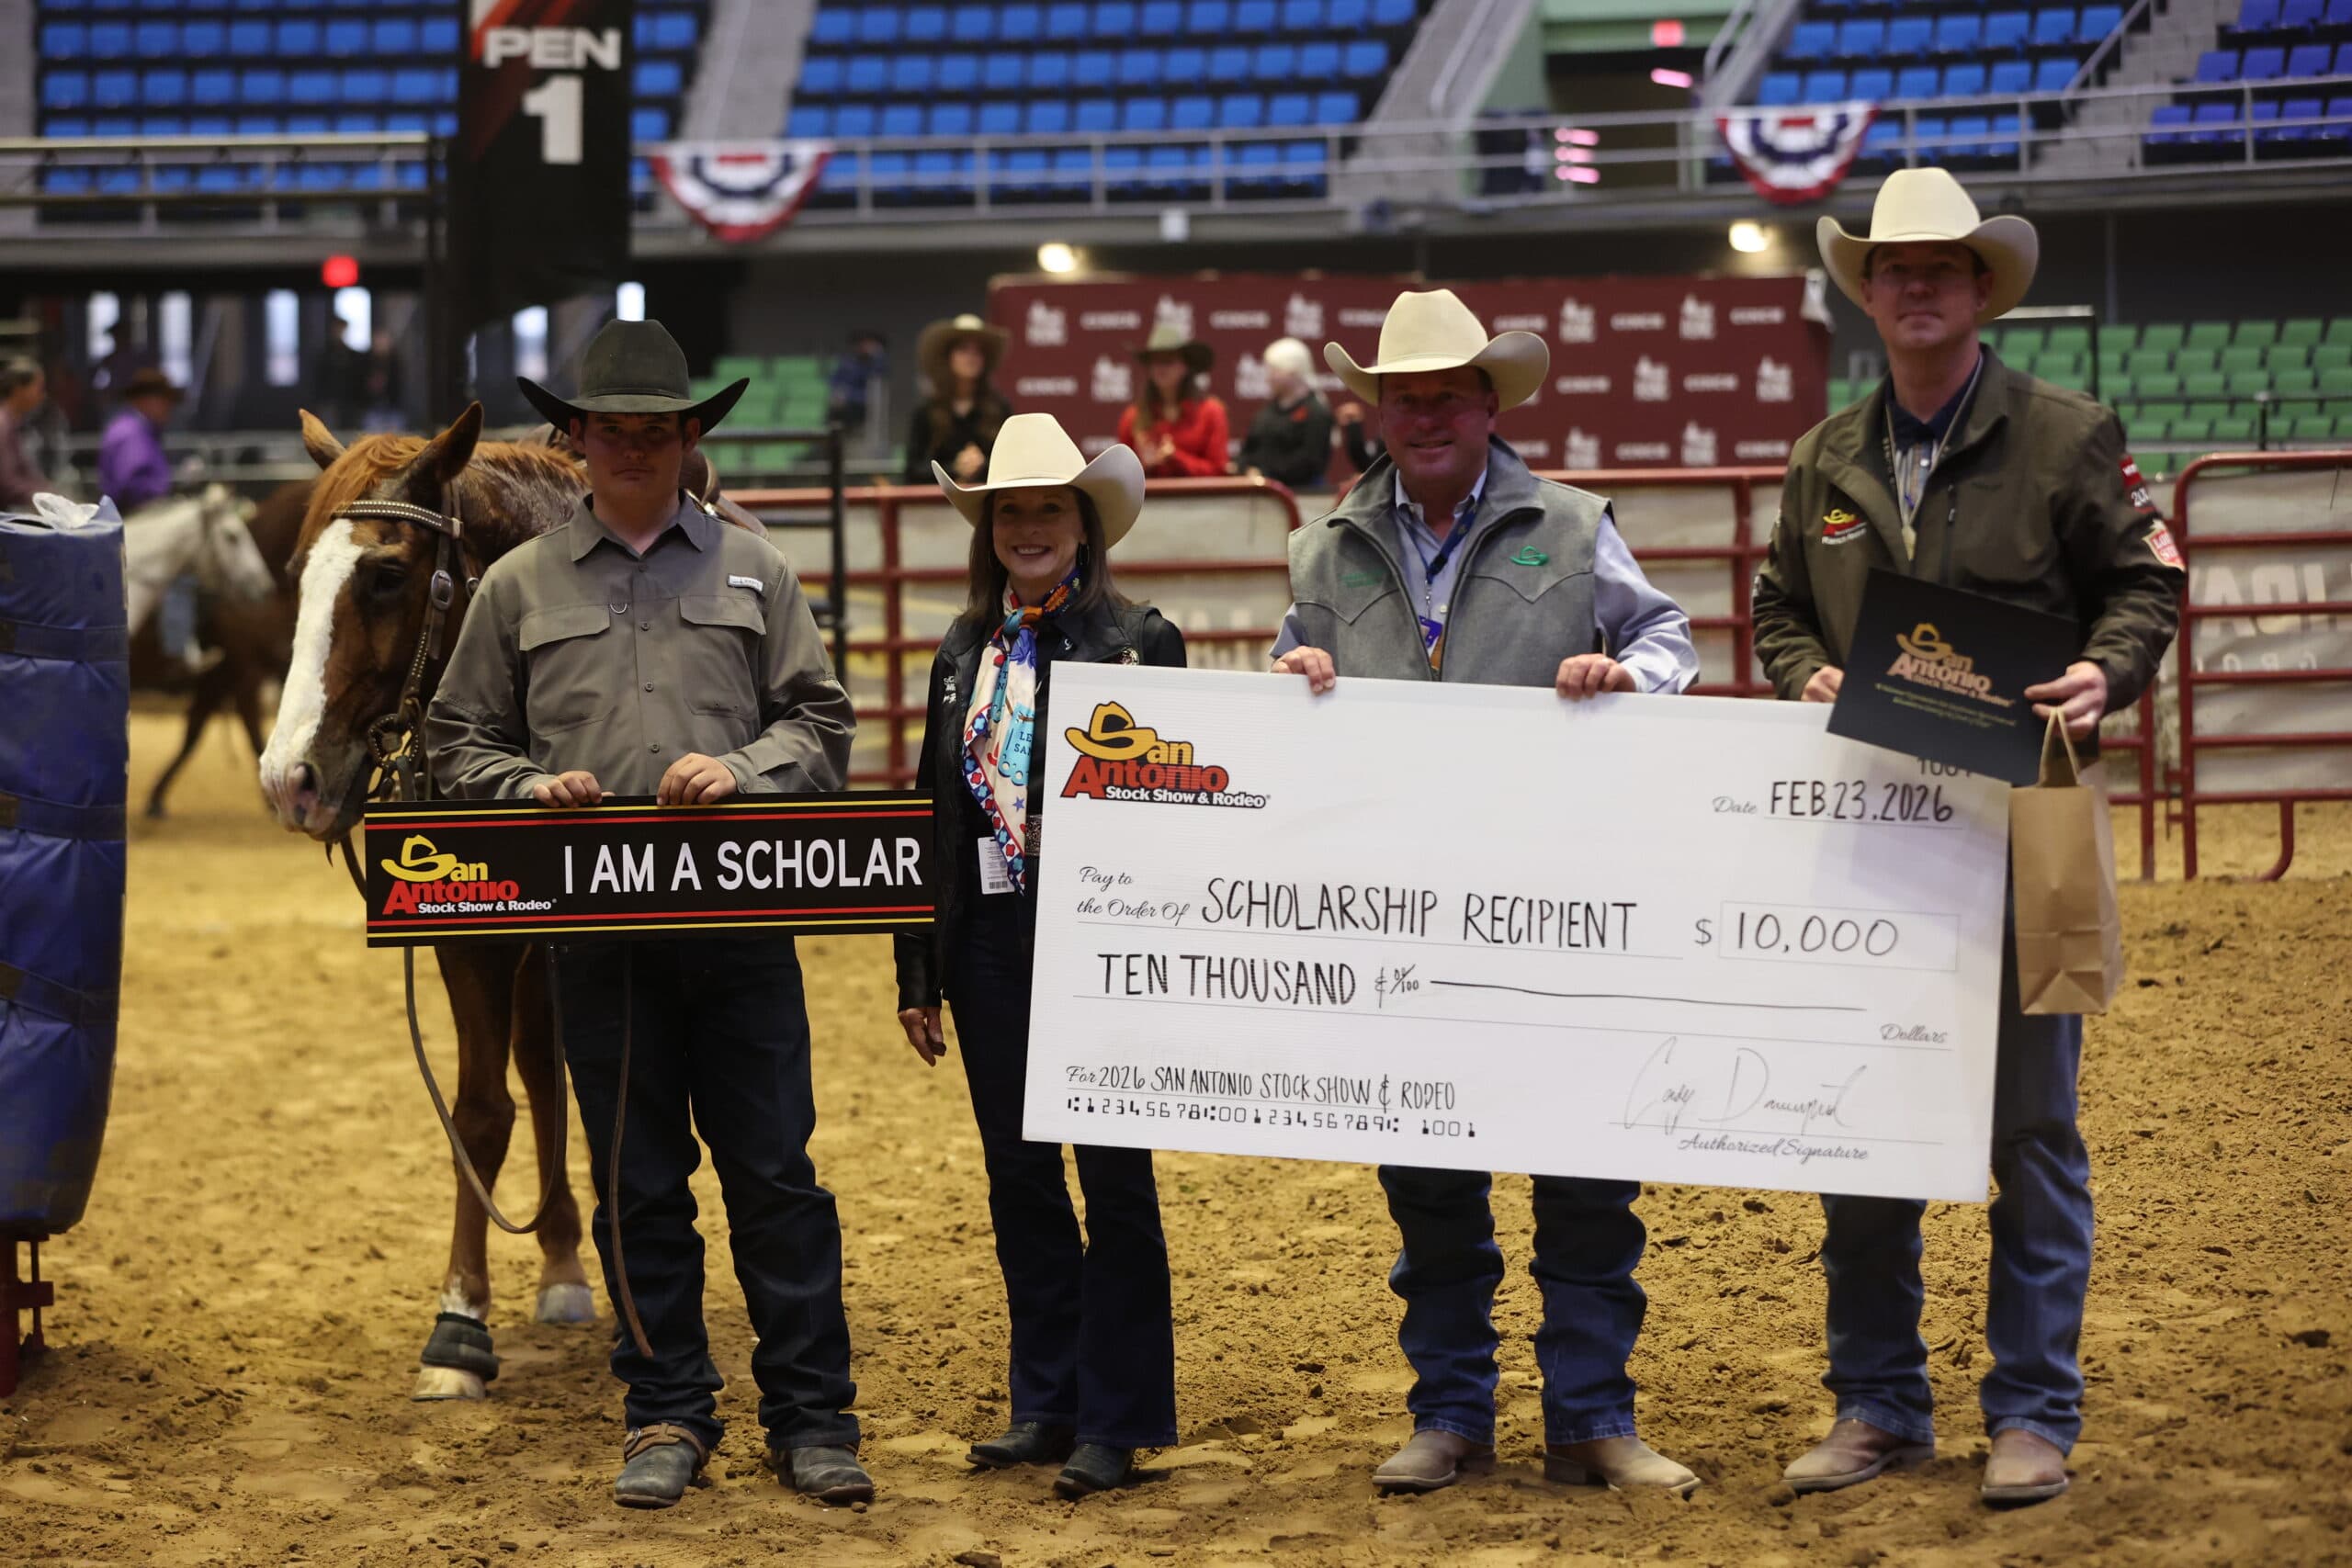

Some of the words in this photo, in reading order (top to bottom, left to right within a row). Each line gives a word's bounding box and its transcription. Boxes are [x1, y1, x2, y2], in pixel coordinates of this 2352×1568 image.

[484, 28, 622, 70] PEN
[523, 75, 582, 165] 1
[1886, 651, 1993, 694] Antonio
[1065, 701, 1193, 765] San
[1060, 755, 1229, 799] Antonio
[1917, 757, 1971, 778] 100
[1106, 786, 1150, 801] Stock
[1152, 787, 1196, 803] Show
[1197, 791, 1210, 805] &
[1212, 792, 1265, 808] Rodeo
[1713, 795, 1758, 815] Date
[381, 834, 489, 882] San
[565, 846, 573, 894] I
[589, 843, 654, 893] AM
[671, 842, 702, 891] A
[717, 837, 923, 890] SCHOLAR
[1080, 866, 1114, 892] Pay
[1118, 872, 1133, 886] to
[382, 880, 520, 915] Antonio
[419, 901, 456, 914] Stock
[458, 901, 494, 913] Show
[495, 900, 506, 912] &
[508, 899, 552, 911] Rodeo
[1077, 898, 1102, 915] the
[1107, 899, 1157, 919] Order
[1161, 902, 1190, 926] Of
[1202, 877, 1438, 937] SCHOLARSHIP
[1464, 893, 1638, 952] RECIPIENT
[1695, 919, 1713, 946] $
[1737, 911, 1899, 956] 10,000
[1098, 953, 1168, 996] TEN
[1180, 954, 1356, 1006] THOUSAND
[1881, 1023, 1948, 1044] Dollars
[1066, 1066, 1097, 1084] For
[1099, 1066, 1146, 1089] 2026
[1150, 1066, 1185, 1092] SAN
[1190, 1069, 1252, 1098] ANTONIO
[1260, 1074, 1310, 1101] STOCK
[1317, 1075, 1371, 1106] SHOW
[1402, 1080, 1455, 1111] RODEO
[1422, 1118, 1476, 1138] 1001
[1678, 1134, 1781, 1158] Authorized
[1782, 1139, 1868, 1165] Signature
